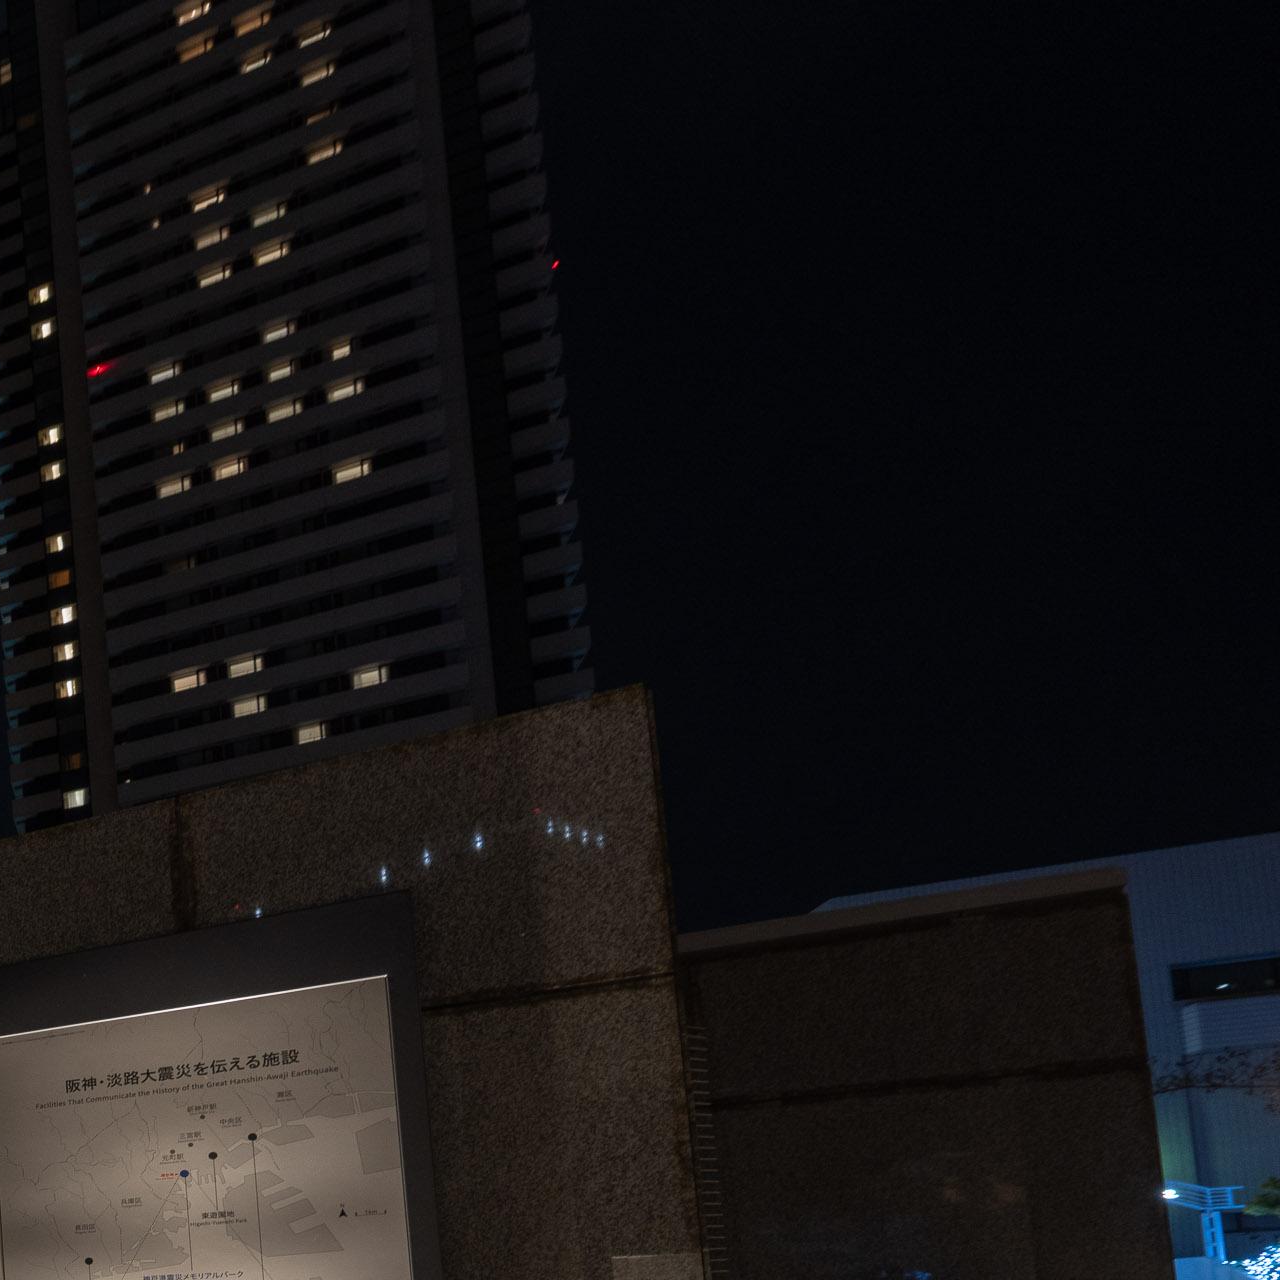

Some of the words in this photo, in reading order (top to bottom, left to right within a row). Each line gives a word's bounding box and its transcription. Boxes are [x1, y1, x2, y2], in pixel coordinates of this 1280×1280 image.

[36, 1101, 66, 1110] Facilities
[68, 1098, 84, 1106] That
[86, 1092, 137, 1104] Communicate
[152, 1086, 180, 1096] History
[206, 1080, 228, 1088] Great
[230, 1072, 289, 1085] Hanshin-Awaji
[291, 1066, 339, 1078] Earthquake
[66, 1049, 300, 1093] 阪神・淡路大震災を伝える施設
[202, 1211, 235, 1219] 東遊園地
